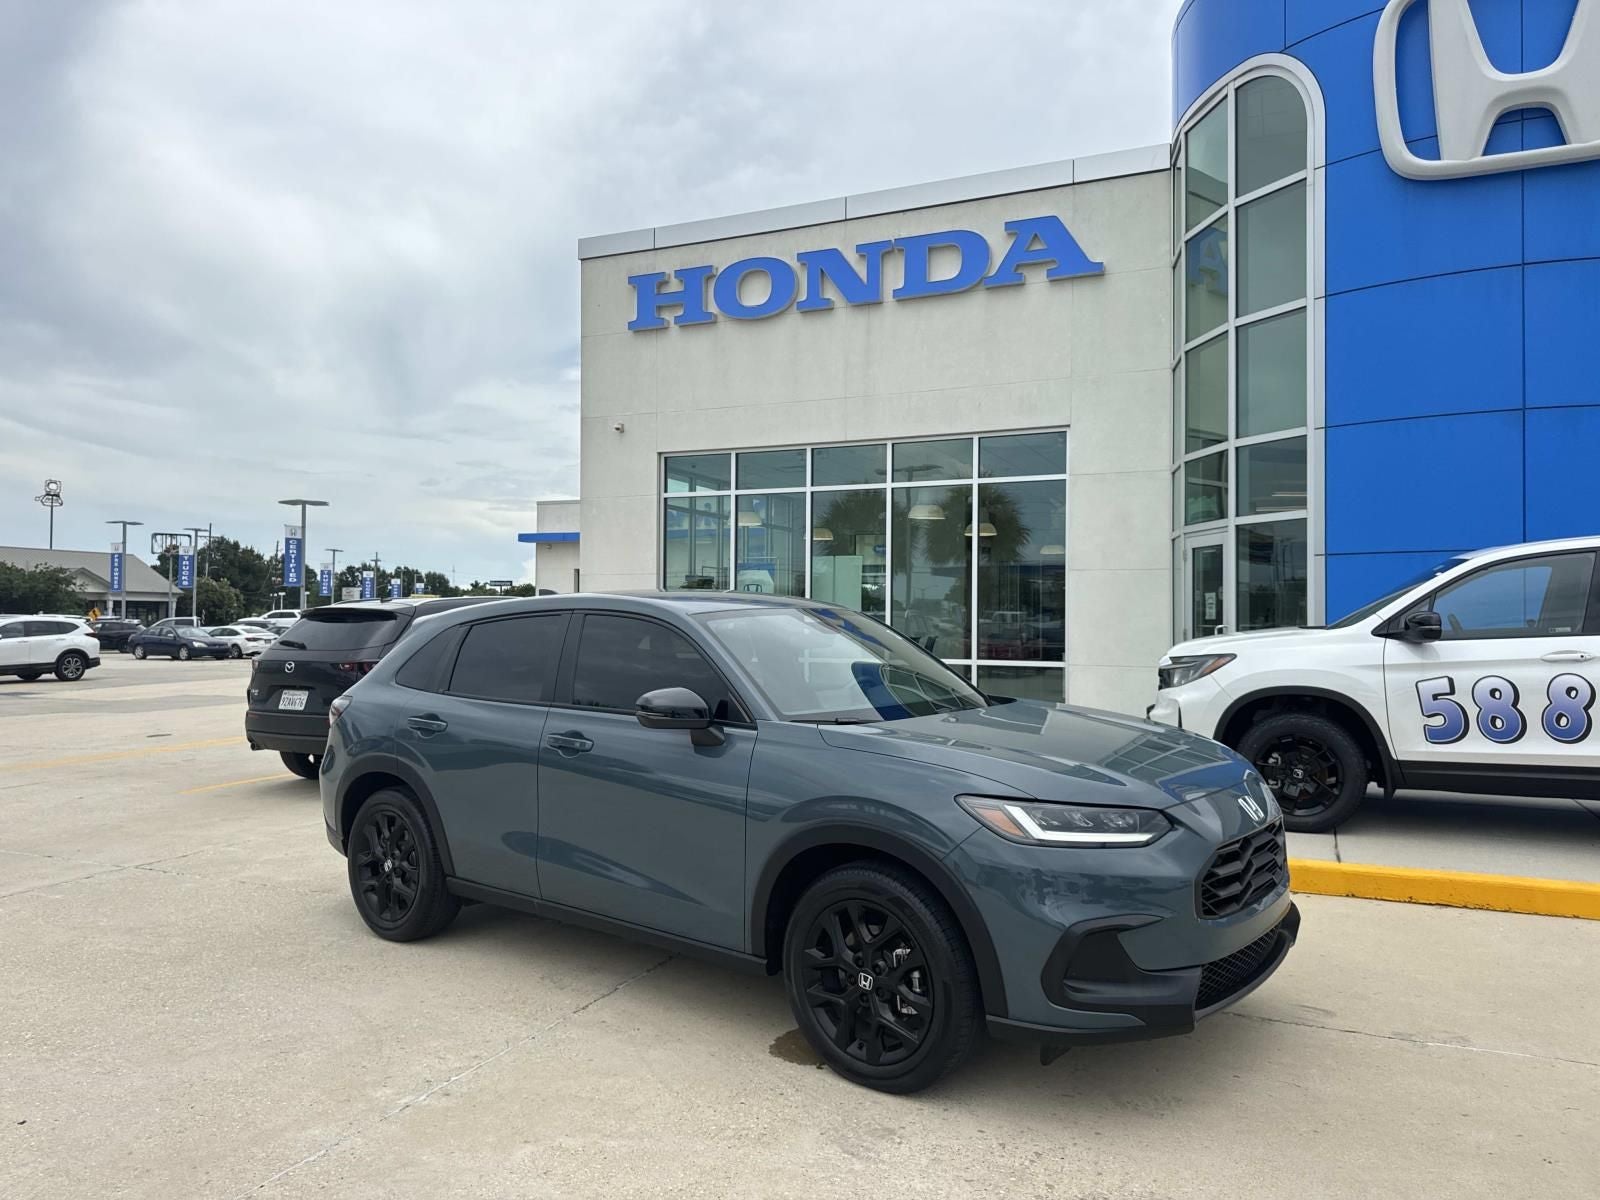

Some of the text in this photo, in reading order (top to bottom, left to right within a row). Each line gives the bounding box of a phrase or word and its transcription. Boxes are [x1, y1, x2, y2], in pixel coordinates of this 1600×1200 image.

[628, 215, 1104, 331] HONDA
[181, 555, 190, 586] TRUCKS
[288, 539, 297, 583] CERTIFIED
[1415, 673, 1597, 745] 588
